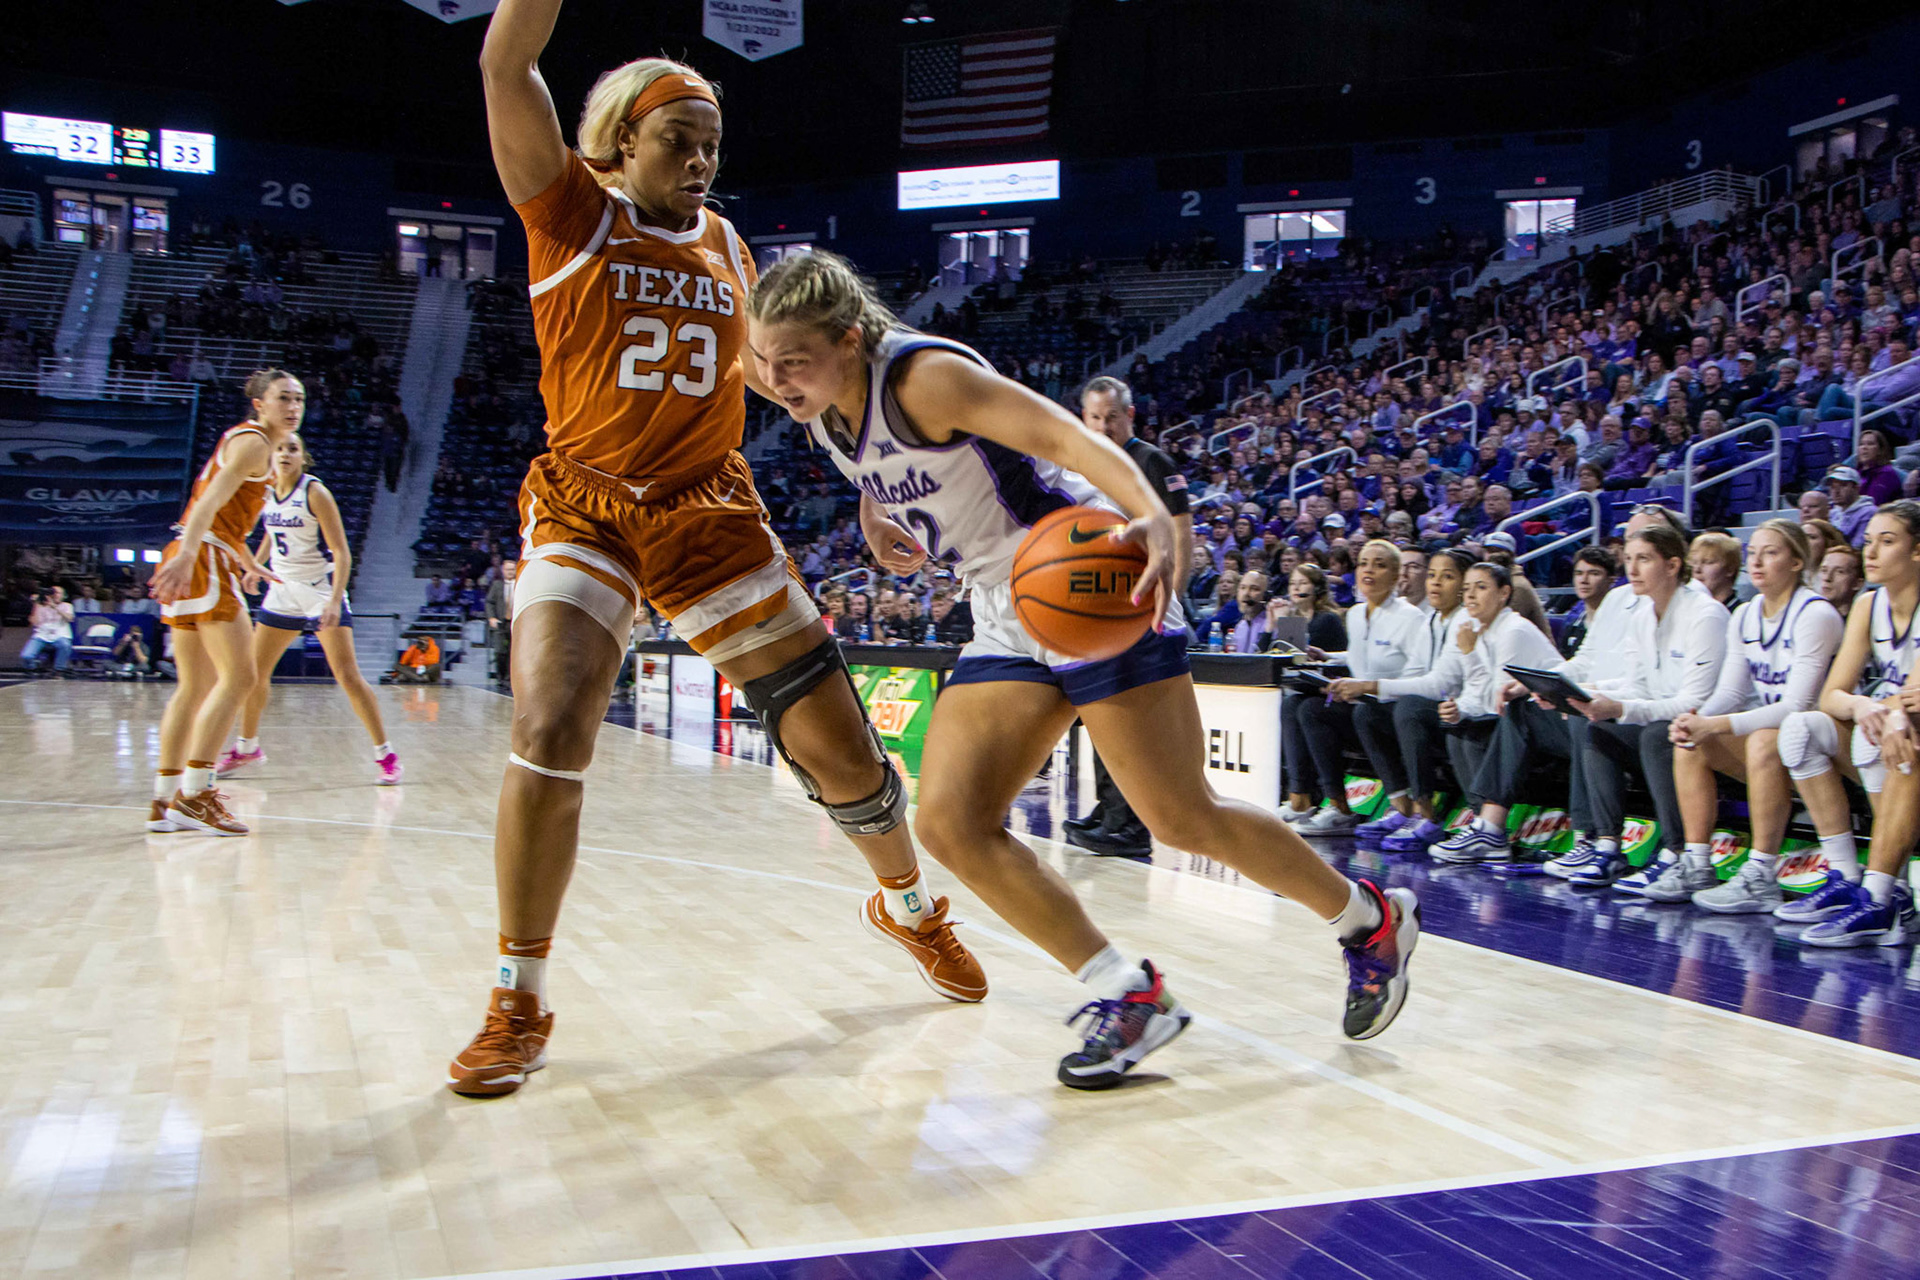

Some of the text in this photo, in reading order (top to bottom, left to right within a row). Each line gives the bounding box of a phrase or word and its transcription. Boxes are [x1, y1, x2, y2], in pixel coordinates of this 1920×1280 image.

[709, 1, 739, 12] NCAA
[740, 5, 789, 18] DIVISION
[68, 134, 99, 154] 32
[173, 145, 200, 164] 33
[1685, 140, 1702, 169] 3
[260, 181, 312, 209] 26
[1180, 190, 1201, 217] 2
[1415, 177, 1436, 204] 3
[827, 215, 837, 240] 1
[608, 262, 735, 317] TEXAS
[617, 315, 718, 398] 23
[25, 487, 161, 501] GLAVAN
[273, 532, 290, 557] 5
[1209, 728, 1250, 773] ELL
